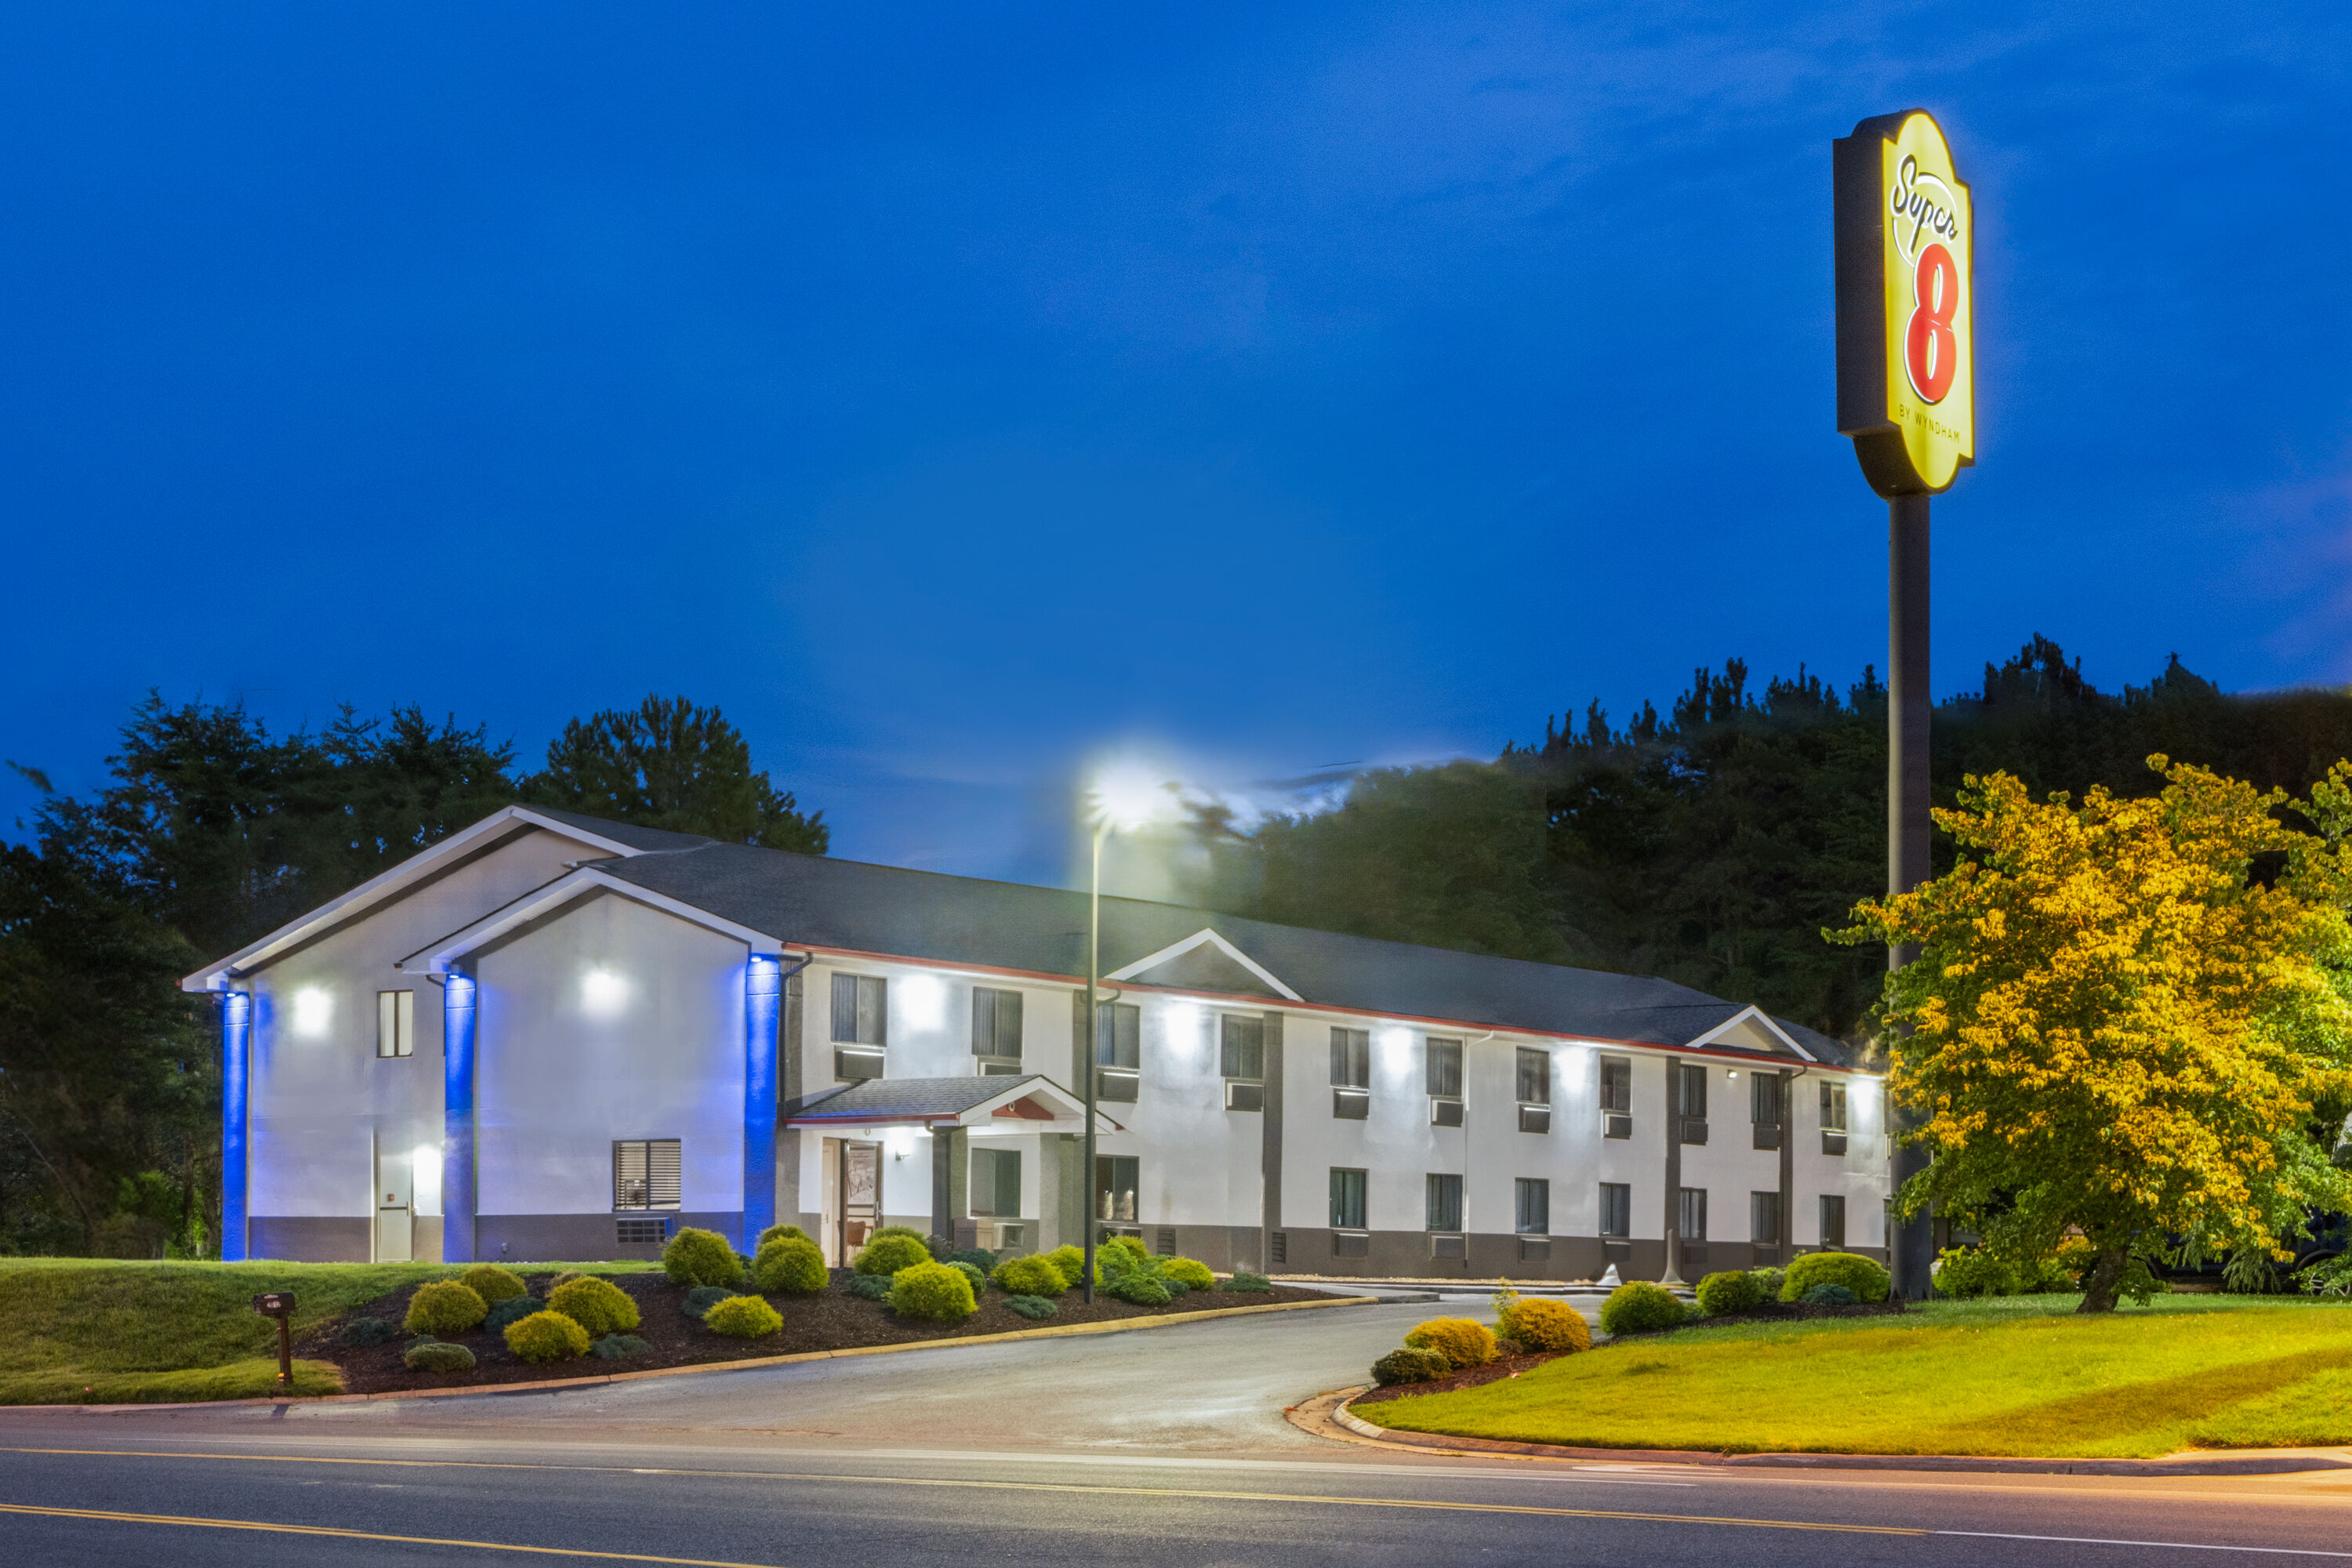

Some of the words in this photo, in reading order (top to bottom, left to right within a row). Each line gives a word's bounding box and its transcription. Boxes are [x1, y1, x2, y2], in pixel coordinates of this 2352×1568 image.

[1890, 154, 1958, 257] Super
[1904, 243, 1958, 405] 8
[1900, 404, 1911, 420] BY
[1915, 411, 1960, 445] WYNDHAM
